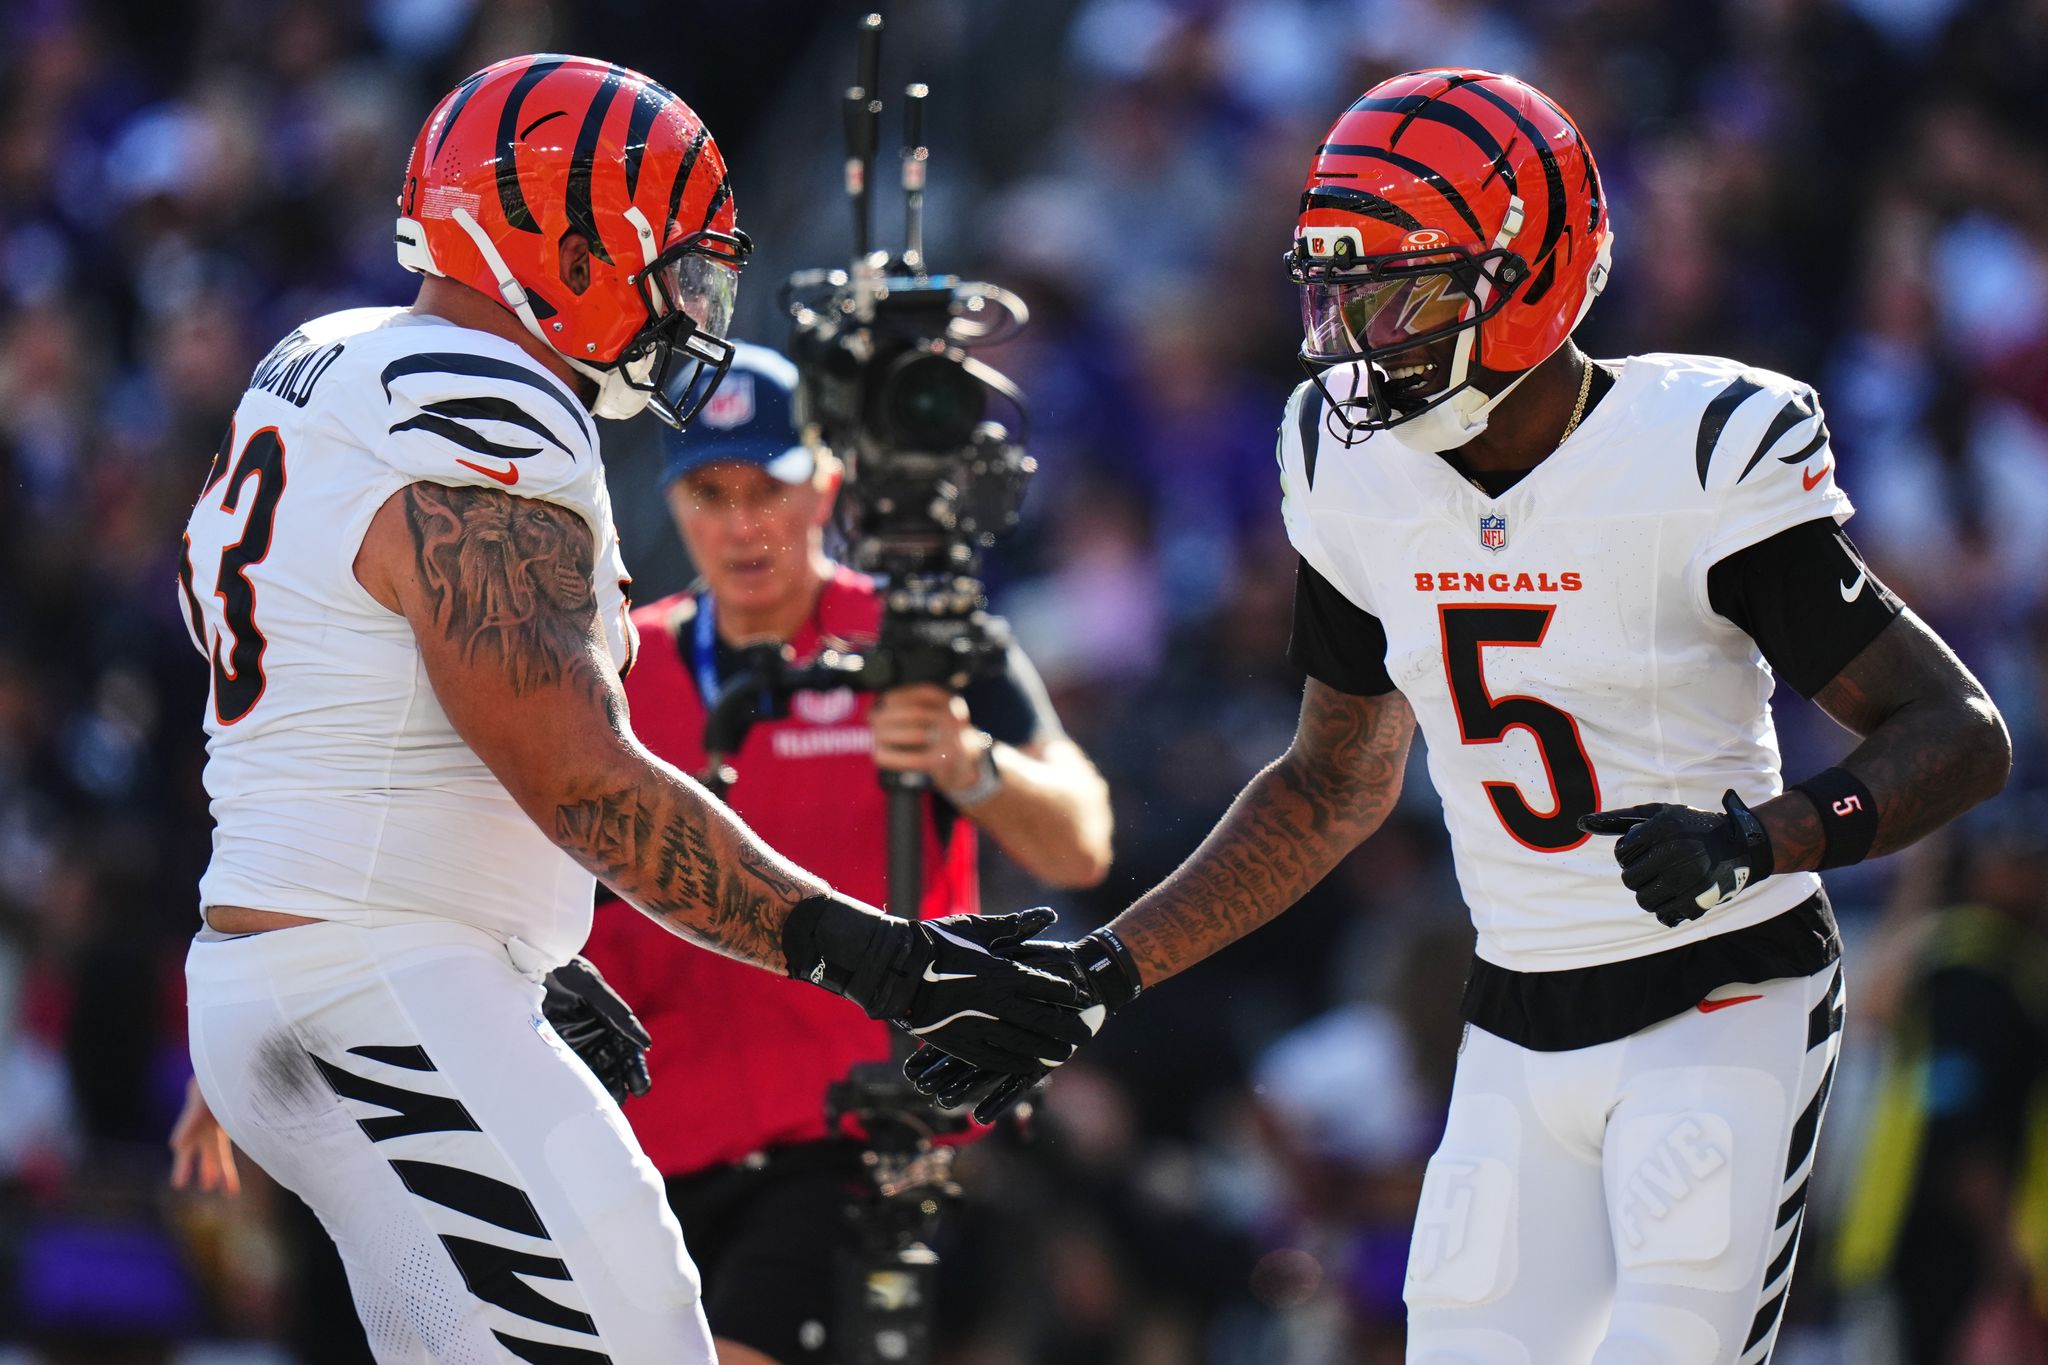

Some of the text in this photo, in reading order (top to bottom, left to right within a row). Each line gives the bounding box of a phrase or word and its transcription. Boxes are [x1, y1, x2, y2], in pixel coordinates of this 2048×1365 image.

[1401, 242, 1447, 252] OAKLEY
[1483, 530, 1504, 547] NFL
[1414, 572, 1583, 592] BENGALS
[1437, 603, 1601, 853] 5
[1832, 794, 1863, 816] 5
[1618, 1116, 1727, 1250] FIVE
